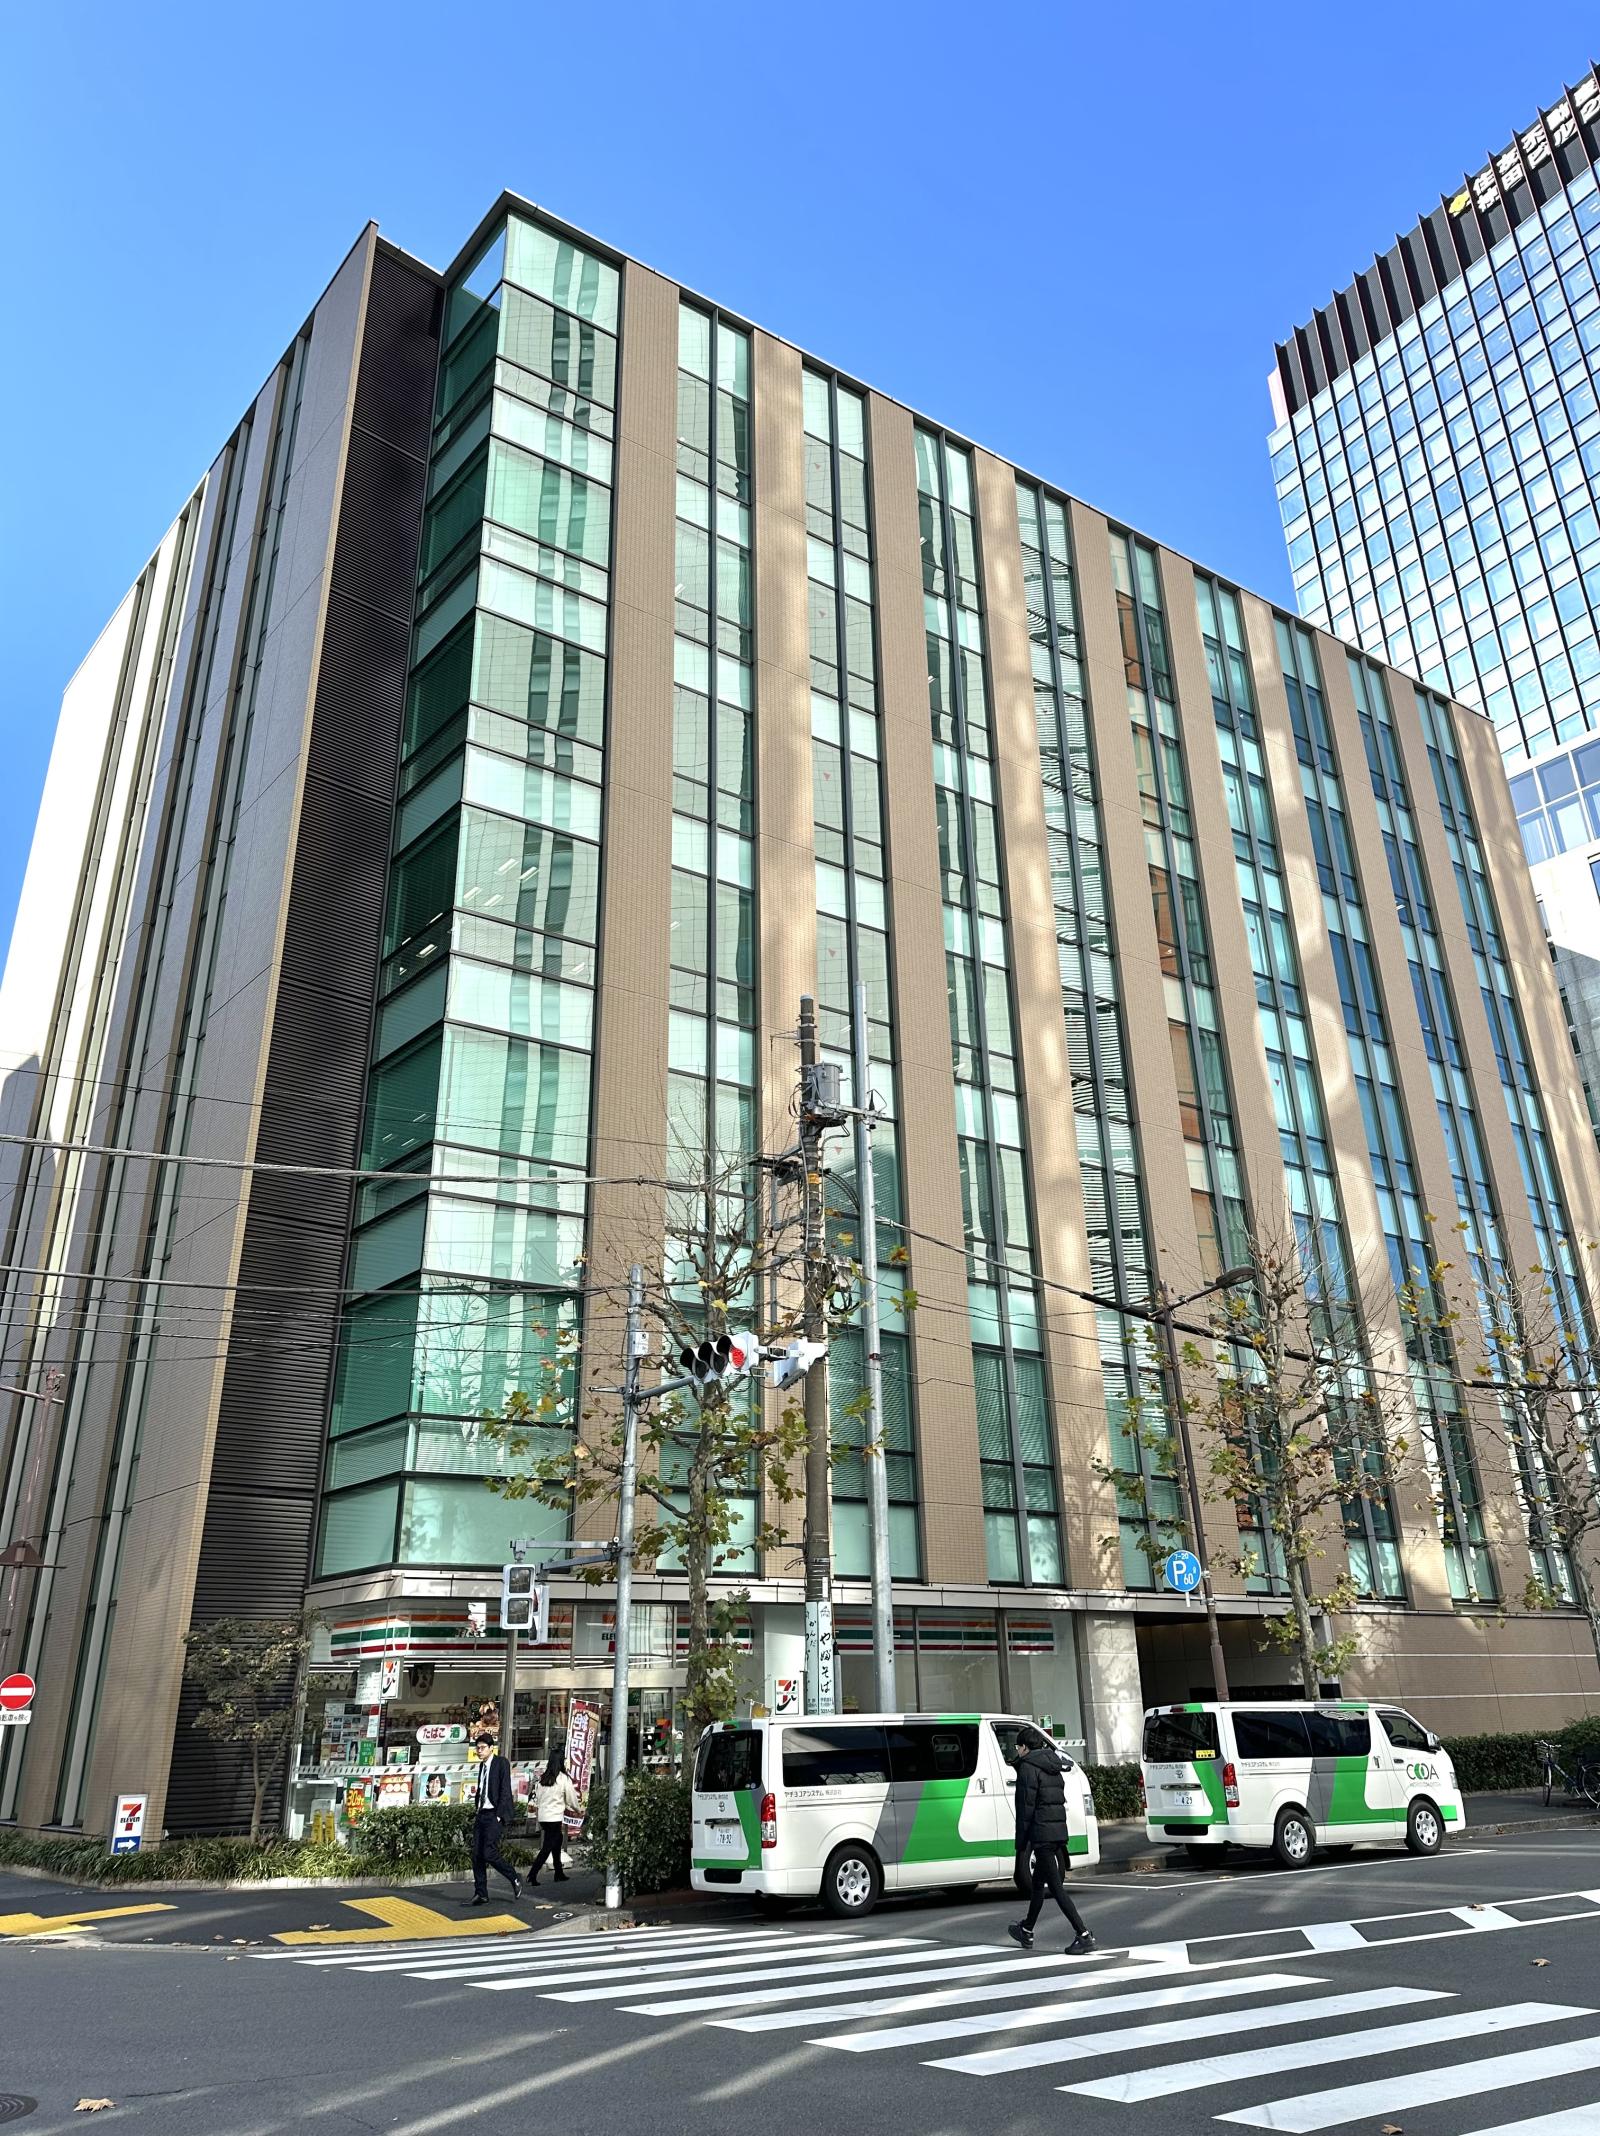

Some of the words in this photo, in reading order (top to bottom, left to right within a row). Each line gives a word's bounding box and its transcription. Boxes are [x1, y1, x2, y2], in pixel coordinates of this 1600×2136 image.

[1173, 1560, 1186, 1586] P
[0, 1713, 29, 1722] 転車を除く
[422, 1727, 446, 1739] たばこ
[120, 1816, 140, 1824] ELEVEN
